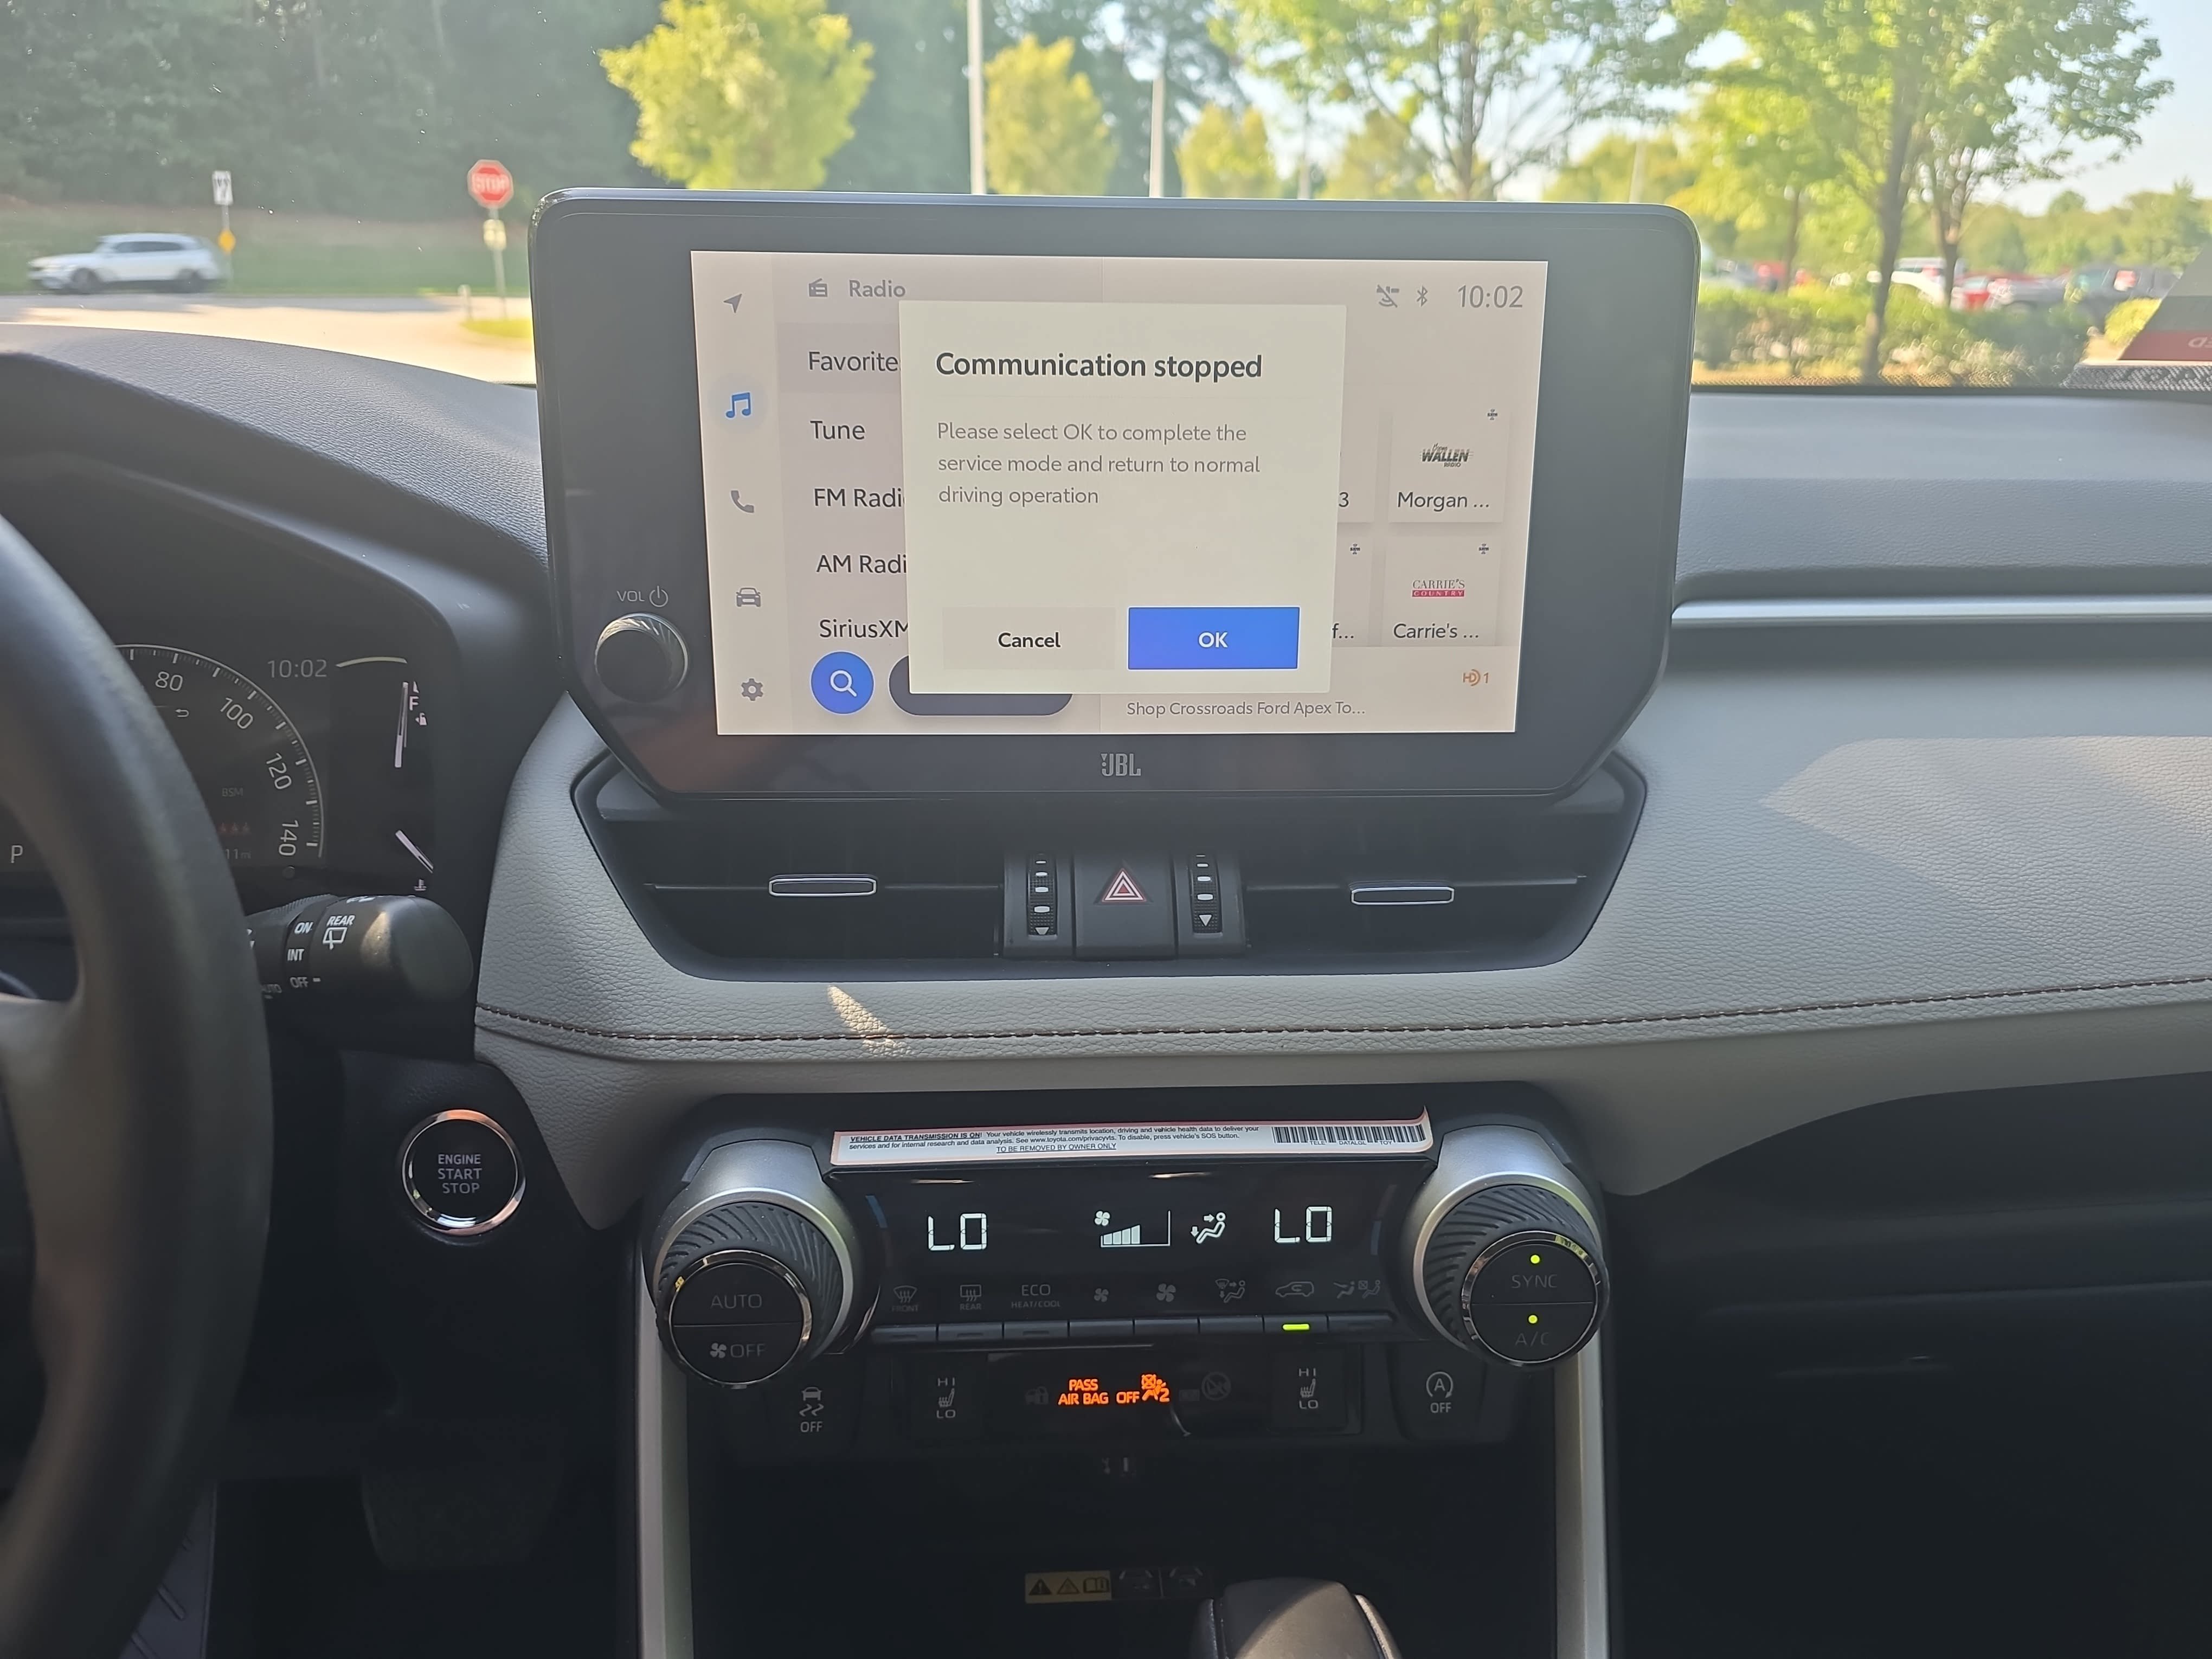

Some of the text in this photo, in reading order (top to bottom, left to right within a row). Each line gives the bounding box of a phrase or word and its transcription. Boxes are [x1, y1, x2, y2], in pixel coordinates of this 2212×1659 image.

[849, 279, 906, 298] Radio
[1457, 285, 1523, 308] 10:02
[808, 351, 901, 372] Favorite
[936, 352, 1263, 383] Communication stopped
[810, 420, 866, 440] Tune
[938, 421, 1246, 446] Please select OK to complete the
[938, 454, 1261, 473] service mode and return to normal
[1421, 449, 1470, 462] WALLEN
[814, 487, 905, 508] FM Radi
[938, 485, 1098, 507] driving operation
[1397, 492, 1468, 512] Morgan
[816, 555, 851, 573] AM
[1412, 578, 1465, 589] CARRIE'S
[616, 590, 645, 602] VOL
[819, 619, 909, 639] SiriusXM
[1393, 623, 1458, 639] Carrie's
[998, 632, 1061, 648] Cancel
[1198, 632, 1228, 648] OK
[267, 659, 327, 678] 10:02
[155, 671, 183, 691] 80
[1483, 672, 1489, 684] 1
[409, 696, 420, 711] F
[1127, 702, 1166, 718] Shop
[1169, 701, 1253, 715] Crossroads
[1257, 701, 1290, 715] Ford
[1293, 702, 1332, 718] Apex
[220, 697, 254, 729] 100
[266, 753, 292, 790] 120
[1101, 753, 1141, 776] JBL
[278, 819, 299, 856] 140
[10, 845, 23, 863] P
[294, 921, 313, 935] ON
[326, 914, 355, 927] REAR
[287, 948, 305, 962] INT
[289, 976, 309, 989] OFF
[438, 1154, 481, 1165] ENGINE
[438, 1168, 483, 1180] START
[442, 1182, 480, 1194] STOP
[928, 1213, 987, 1251] LO
[1274, 1206, 1332, 1243] LO
[1511, 1274, 1558, 1289] SYNC
[1021, 1284, 1051, 1296] ECO
[710, 1294, 762, 1309] AUTO
[1011, 1300, 1062, 1309] HEAT/COOL
[1514, 1330, 1549, 1347] A/C
[730, 1343, 766, 1358] OFF
[1298, 1368, 1317, 1377] HI
[937, 1377, 956, 1387] HI
[1069, 1379, 1099, 1392] PASS
[1058, 1393, 1080, 1405] AIR
[1083, 1392, 1109, 1405] BAG
[1116, 1391, 1140, 1404] OFF
[1298, 1399, 1319, 1410] LO
[936, 1409, 956, 1419] LO
[1430, 1402, 1452, 1413] OFF
[800, 1421, 824, 1433] OFF
